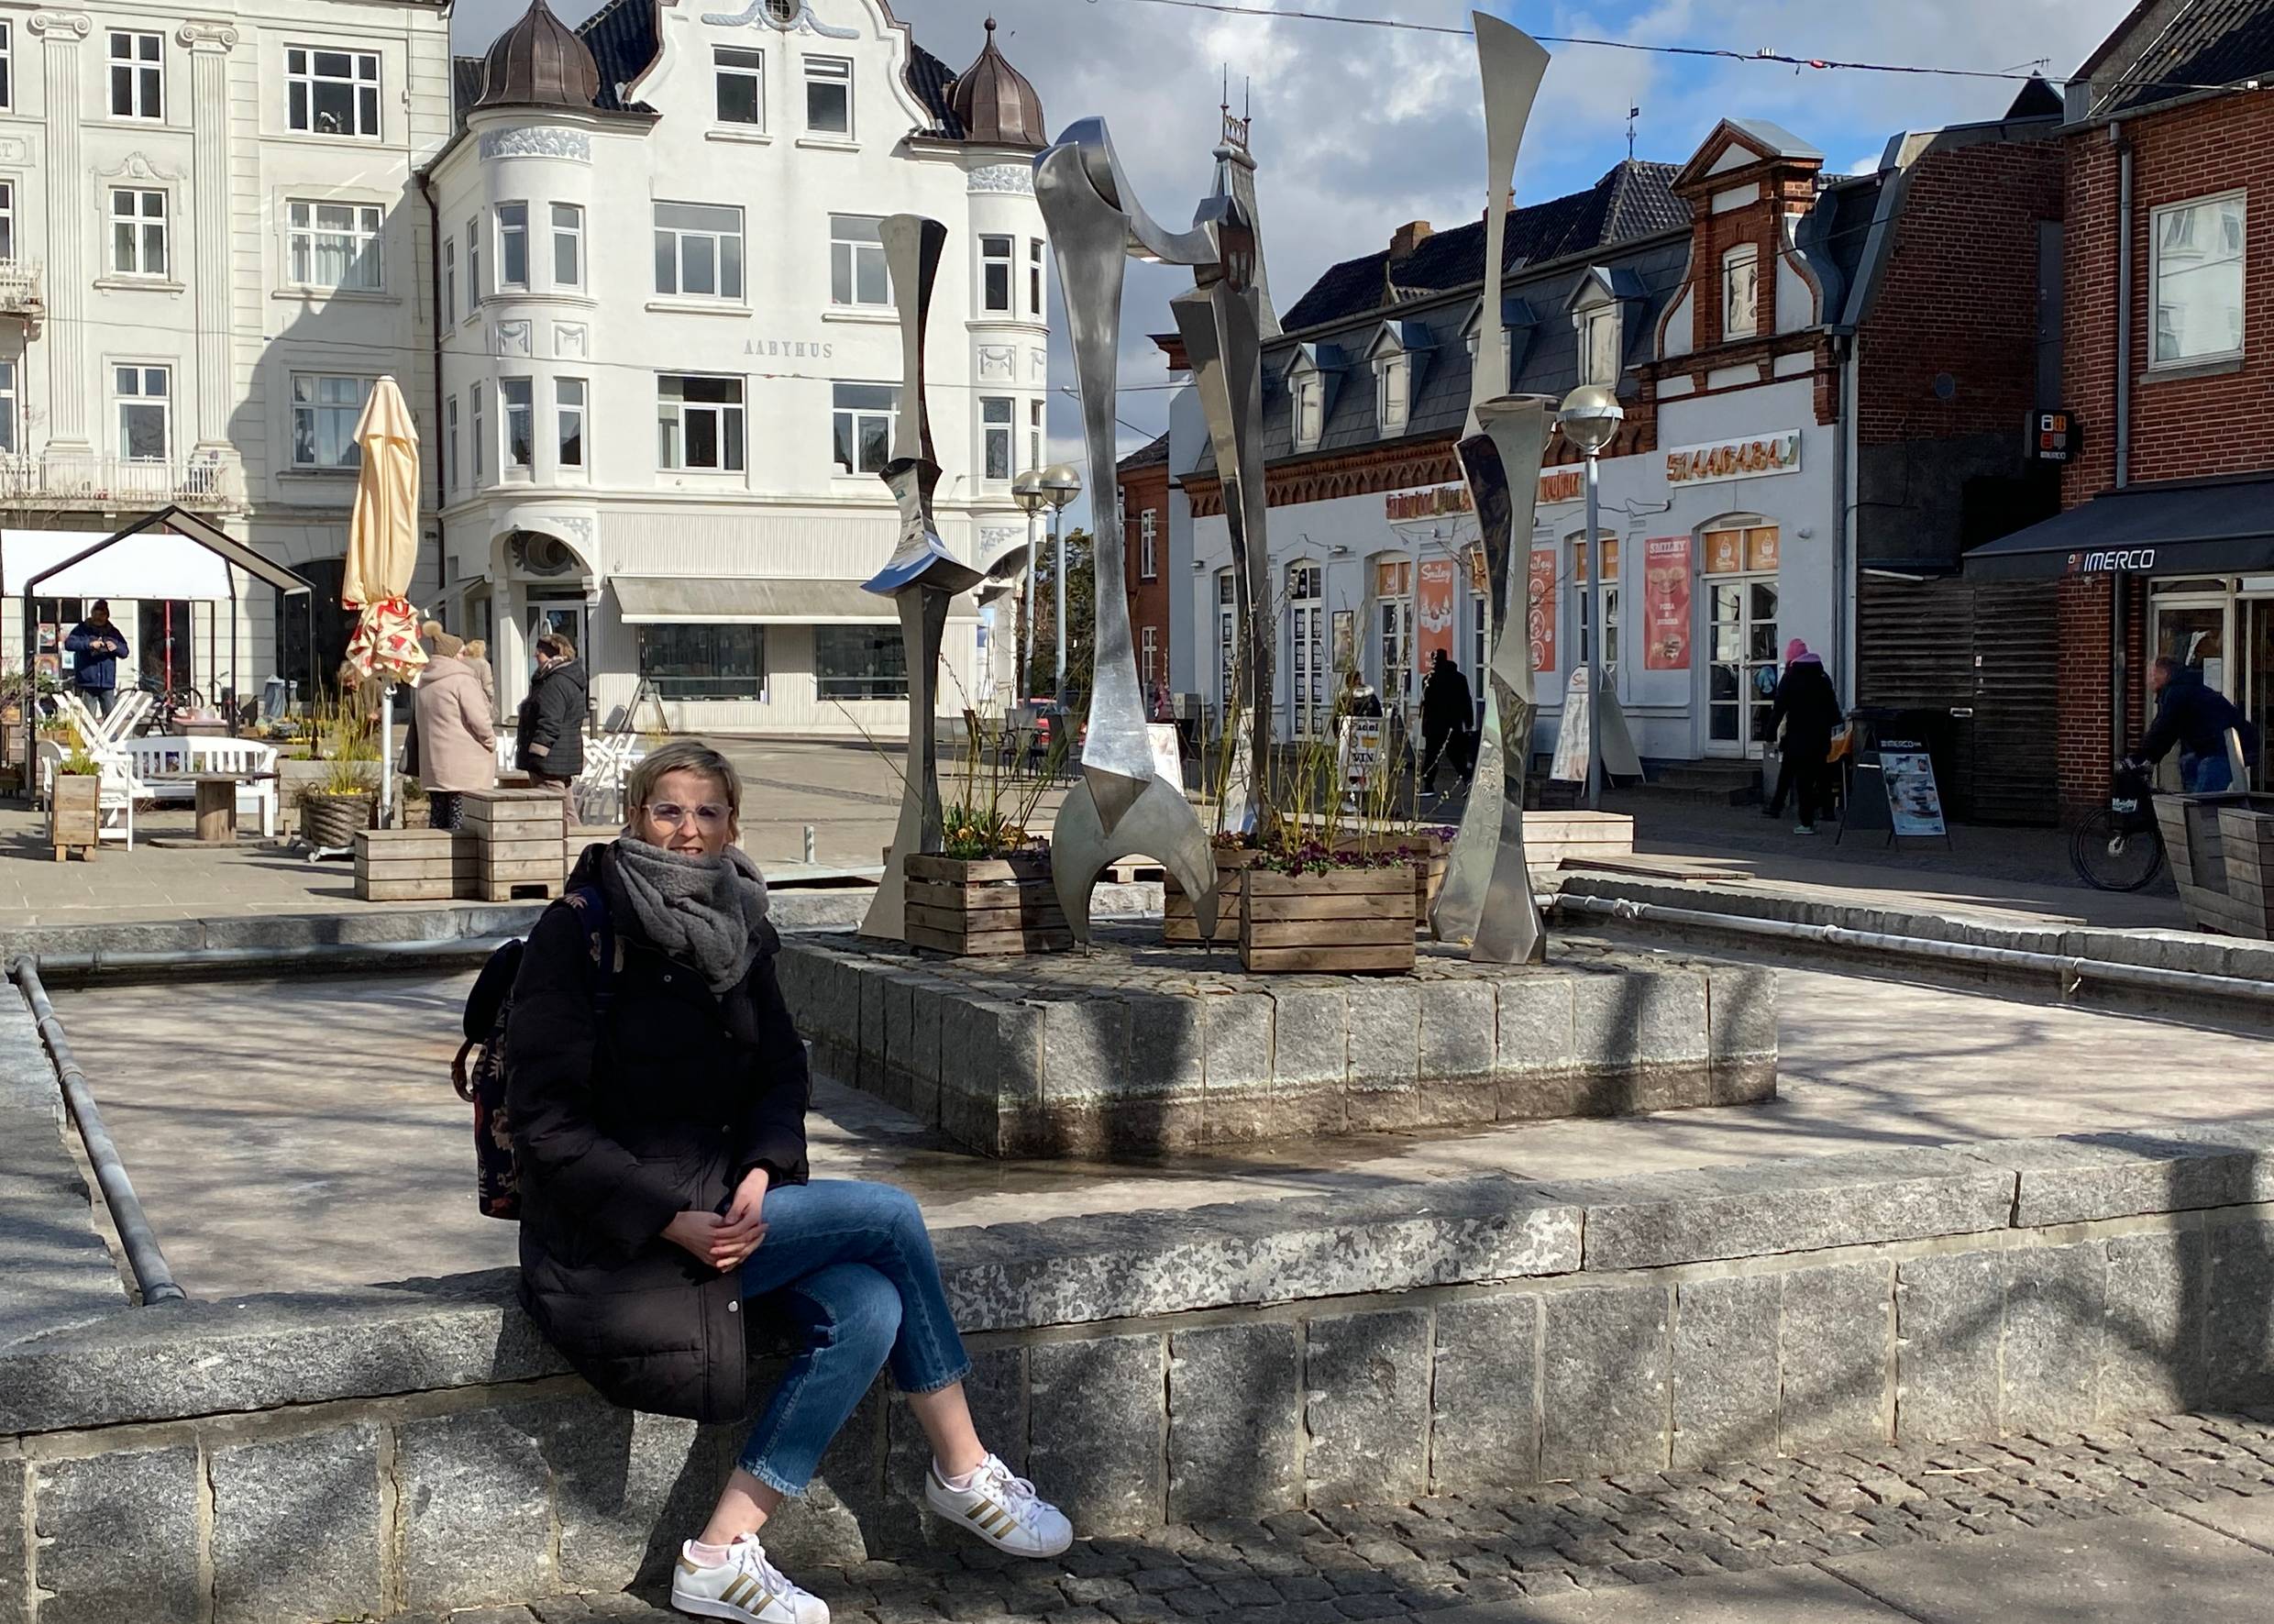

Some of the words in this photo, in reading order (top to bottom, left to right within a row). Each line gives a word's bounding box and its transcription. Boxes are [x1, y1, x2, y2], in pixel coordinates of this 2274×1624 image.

[744, 338, 833, 359] AABYHUS
[2083, 549, 2155, 572] IMERCO
[1421, 563, 1451, 582] Smiley
